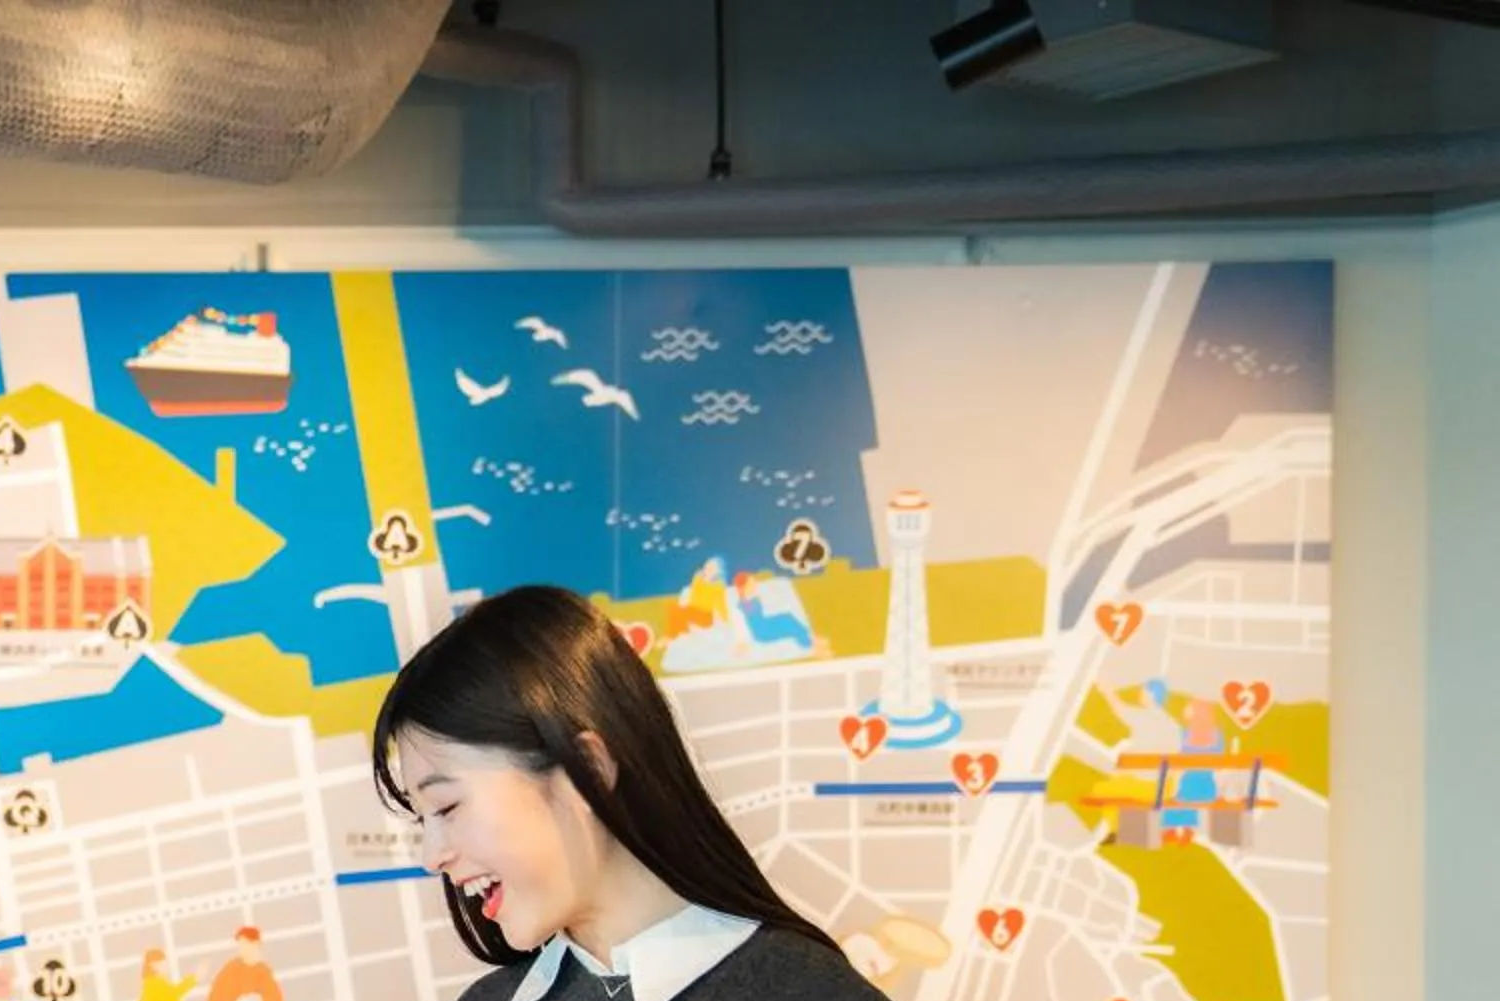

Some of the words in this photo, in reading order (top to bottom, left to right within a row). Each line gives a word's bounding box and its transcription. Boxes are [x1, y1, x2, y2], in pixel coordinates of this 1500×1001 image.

[792, 532, 811, 559] 7
[1110, 613, 1130, 640] 7
[1236, 690, 1257, 717] 2
[850, 727, 869, 754] 4
[965, 761, 984, 787] 3
[991, 918, 1009, 945] 6
[42, 968, 71, 995] 10
